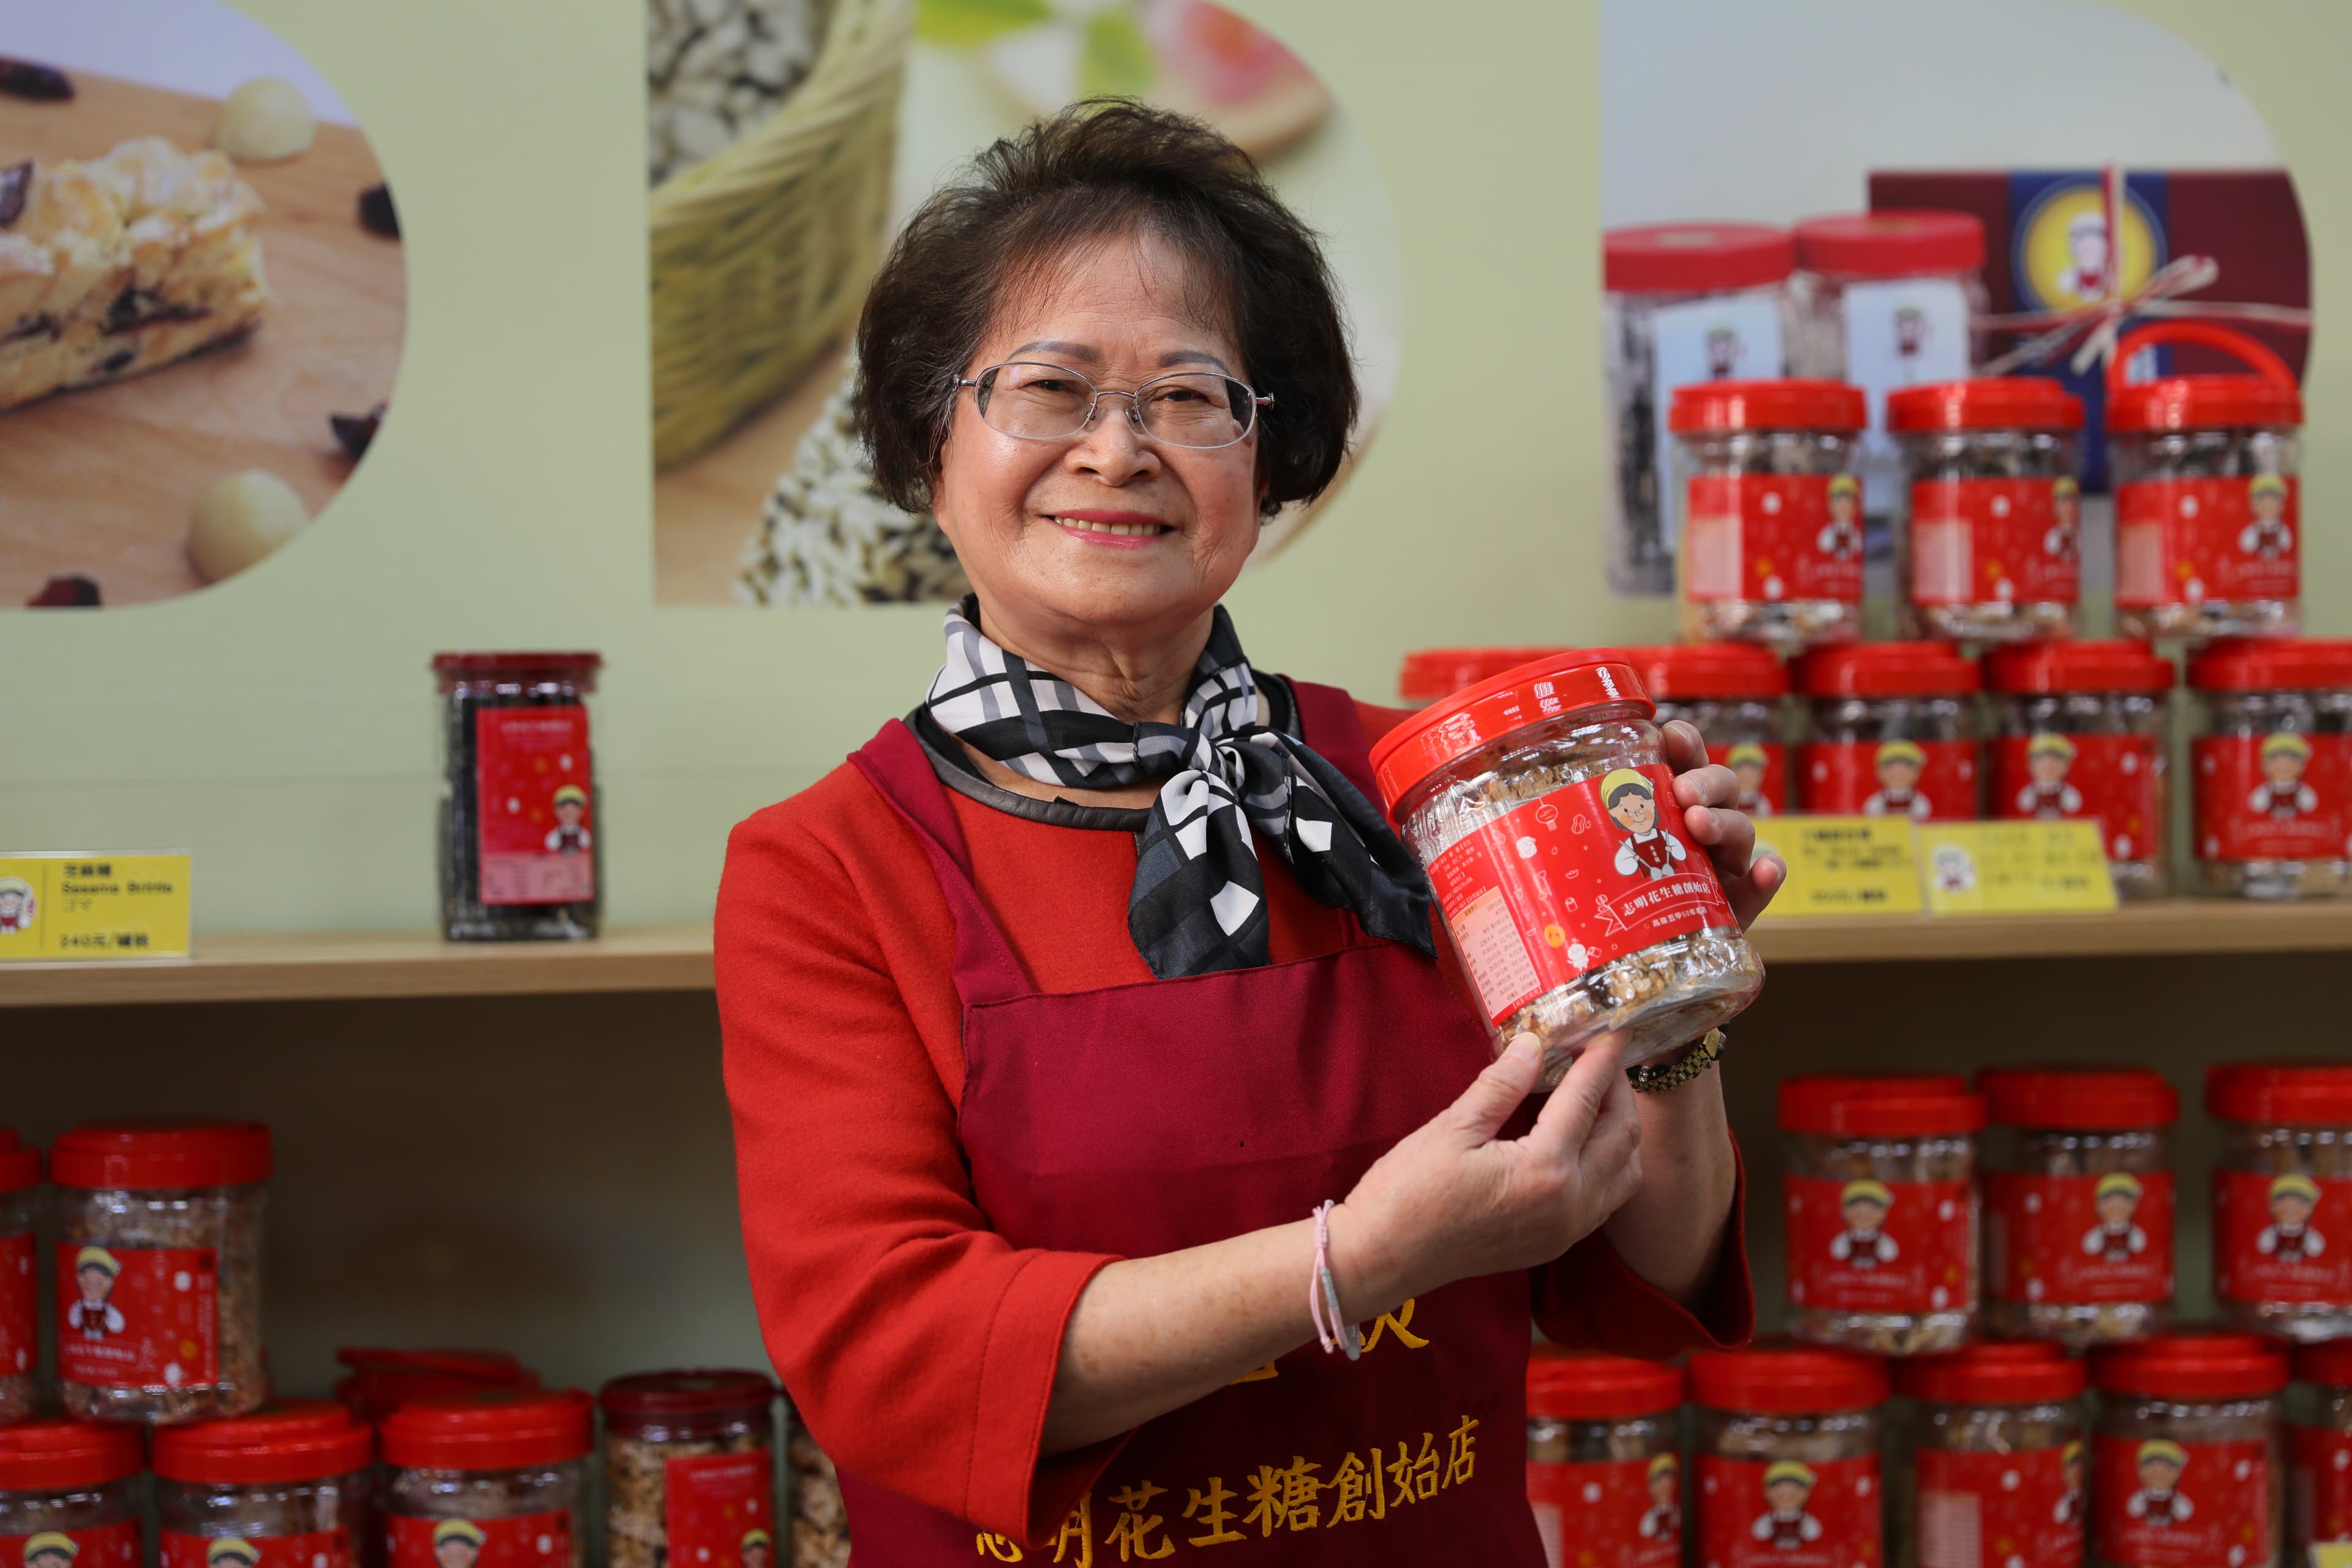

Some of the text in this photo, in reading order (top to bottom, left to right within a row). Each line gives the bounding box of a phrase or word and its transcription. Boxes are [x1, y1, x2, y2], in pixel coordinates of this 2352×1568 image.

[1623, 881, 1711, 916] 志明花生糖創始店
